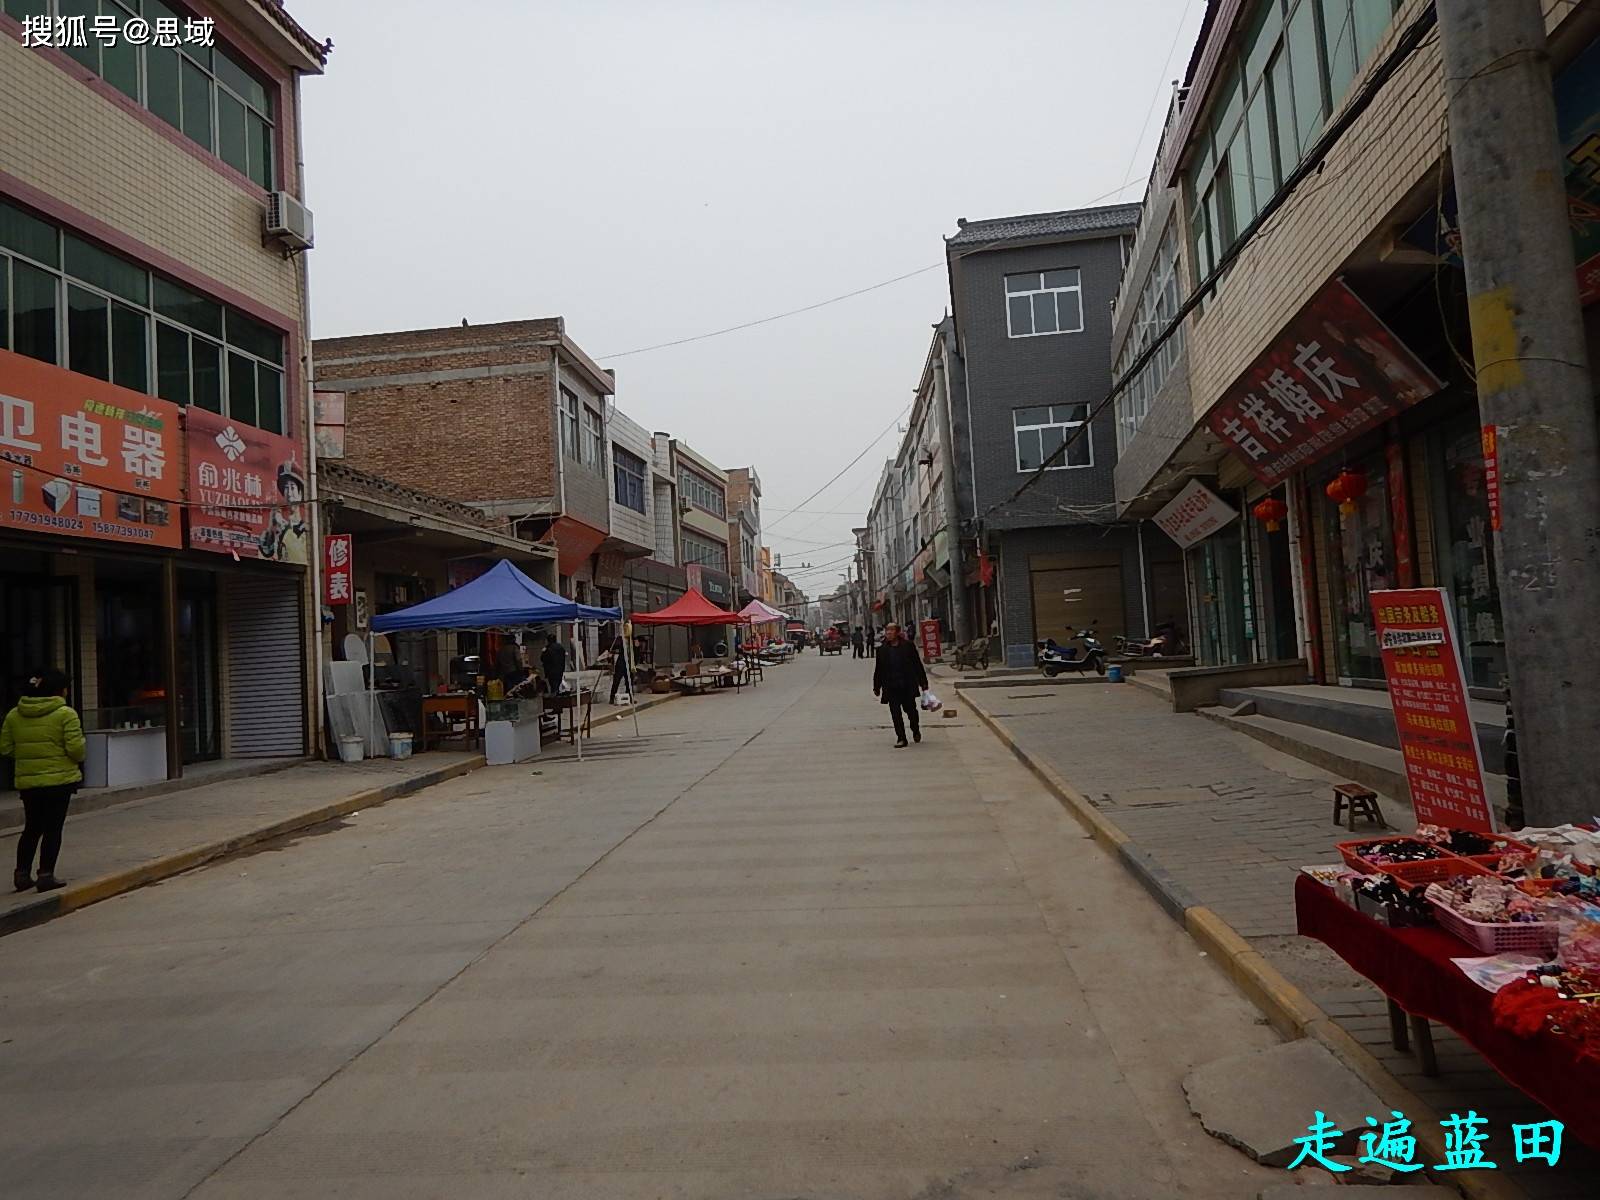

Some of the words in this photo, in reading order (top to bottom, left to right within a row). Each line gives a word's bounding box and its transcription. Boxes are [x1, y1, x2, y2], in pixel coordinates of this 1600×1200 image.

[1221, 340, 1361, 461] 吉祥婚庆
[199, 462, 262, 498] 俞兆林
[10, 510, 84, 530] 17791948024
[329, 539, 348, 600] 修表
